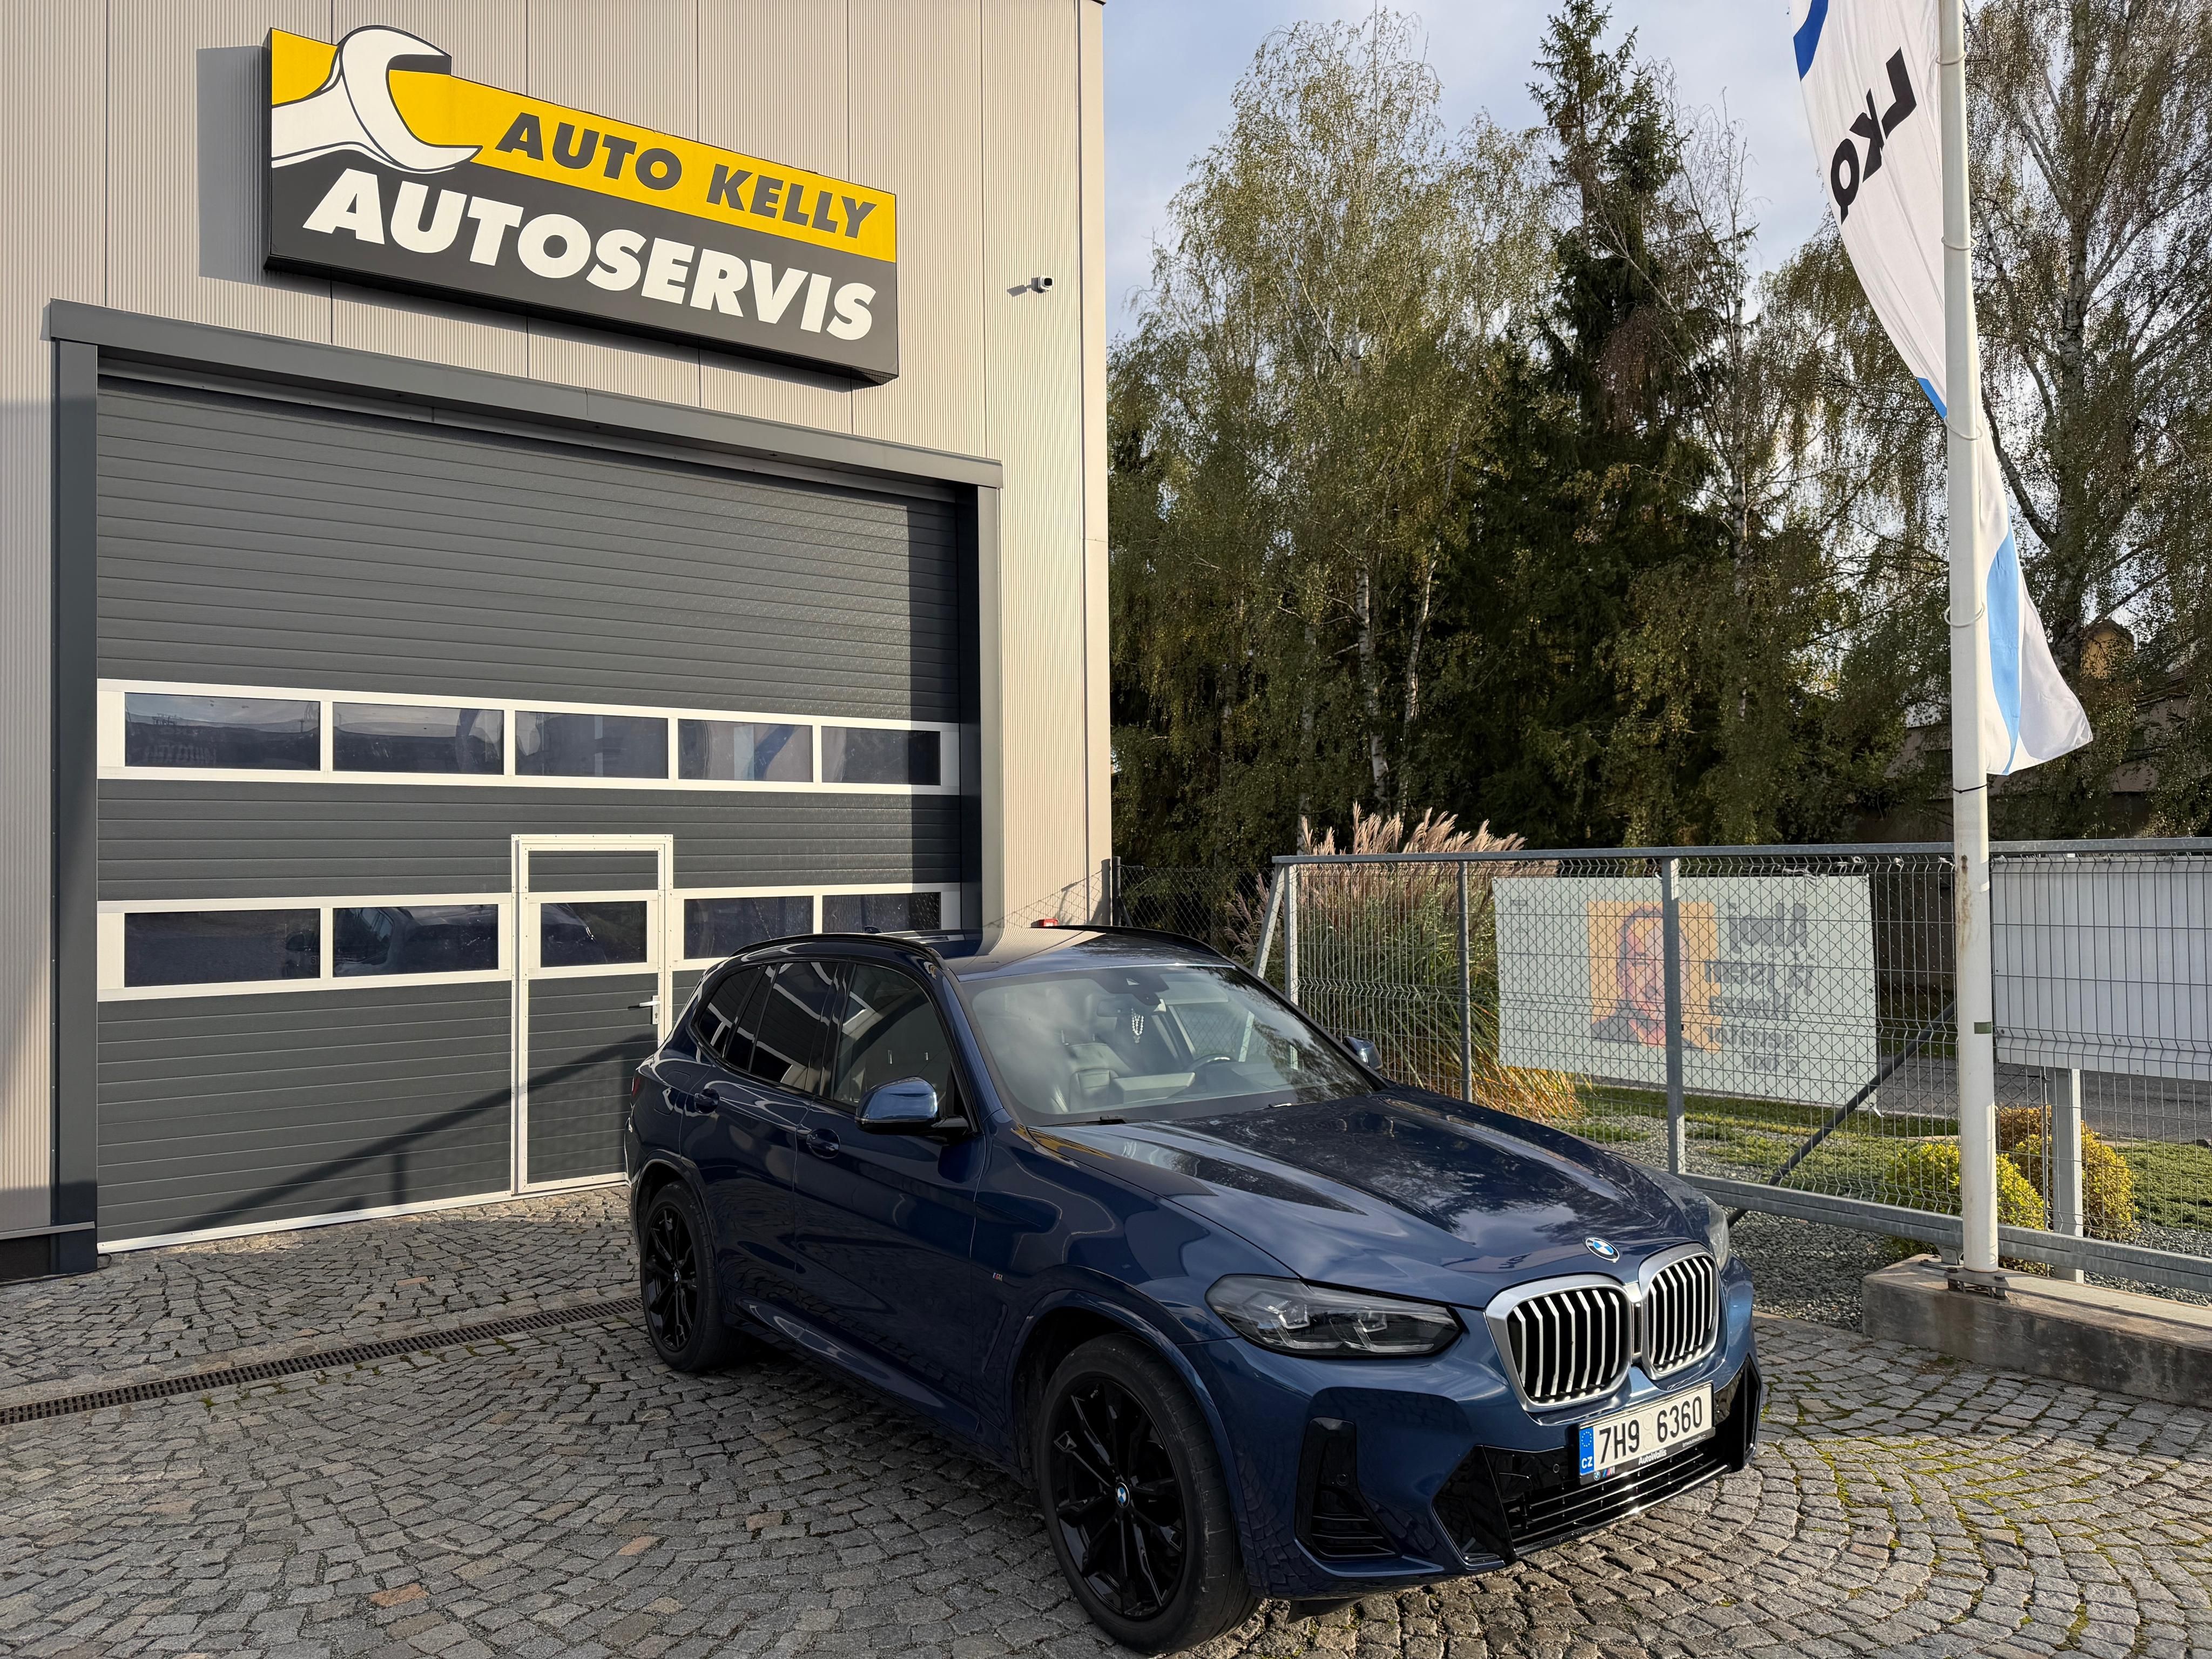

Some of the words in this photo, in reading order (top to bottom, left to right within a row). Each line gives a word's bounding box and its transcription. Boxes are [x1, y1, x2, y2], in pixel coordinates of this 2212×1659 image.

[495, 112, 683, 191] AUTO
[706, 163, 878, 239] KELLY
[302, 168, 876, 341] AUTOSERVIS
[1581, 1456, 1593, 1469] CZ
[1599, 1419, 1640, 1464] 7H9
[1657, 1395, 1703, 1444] 6360
